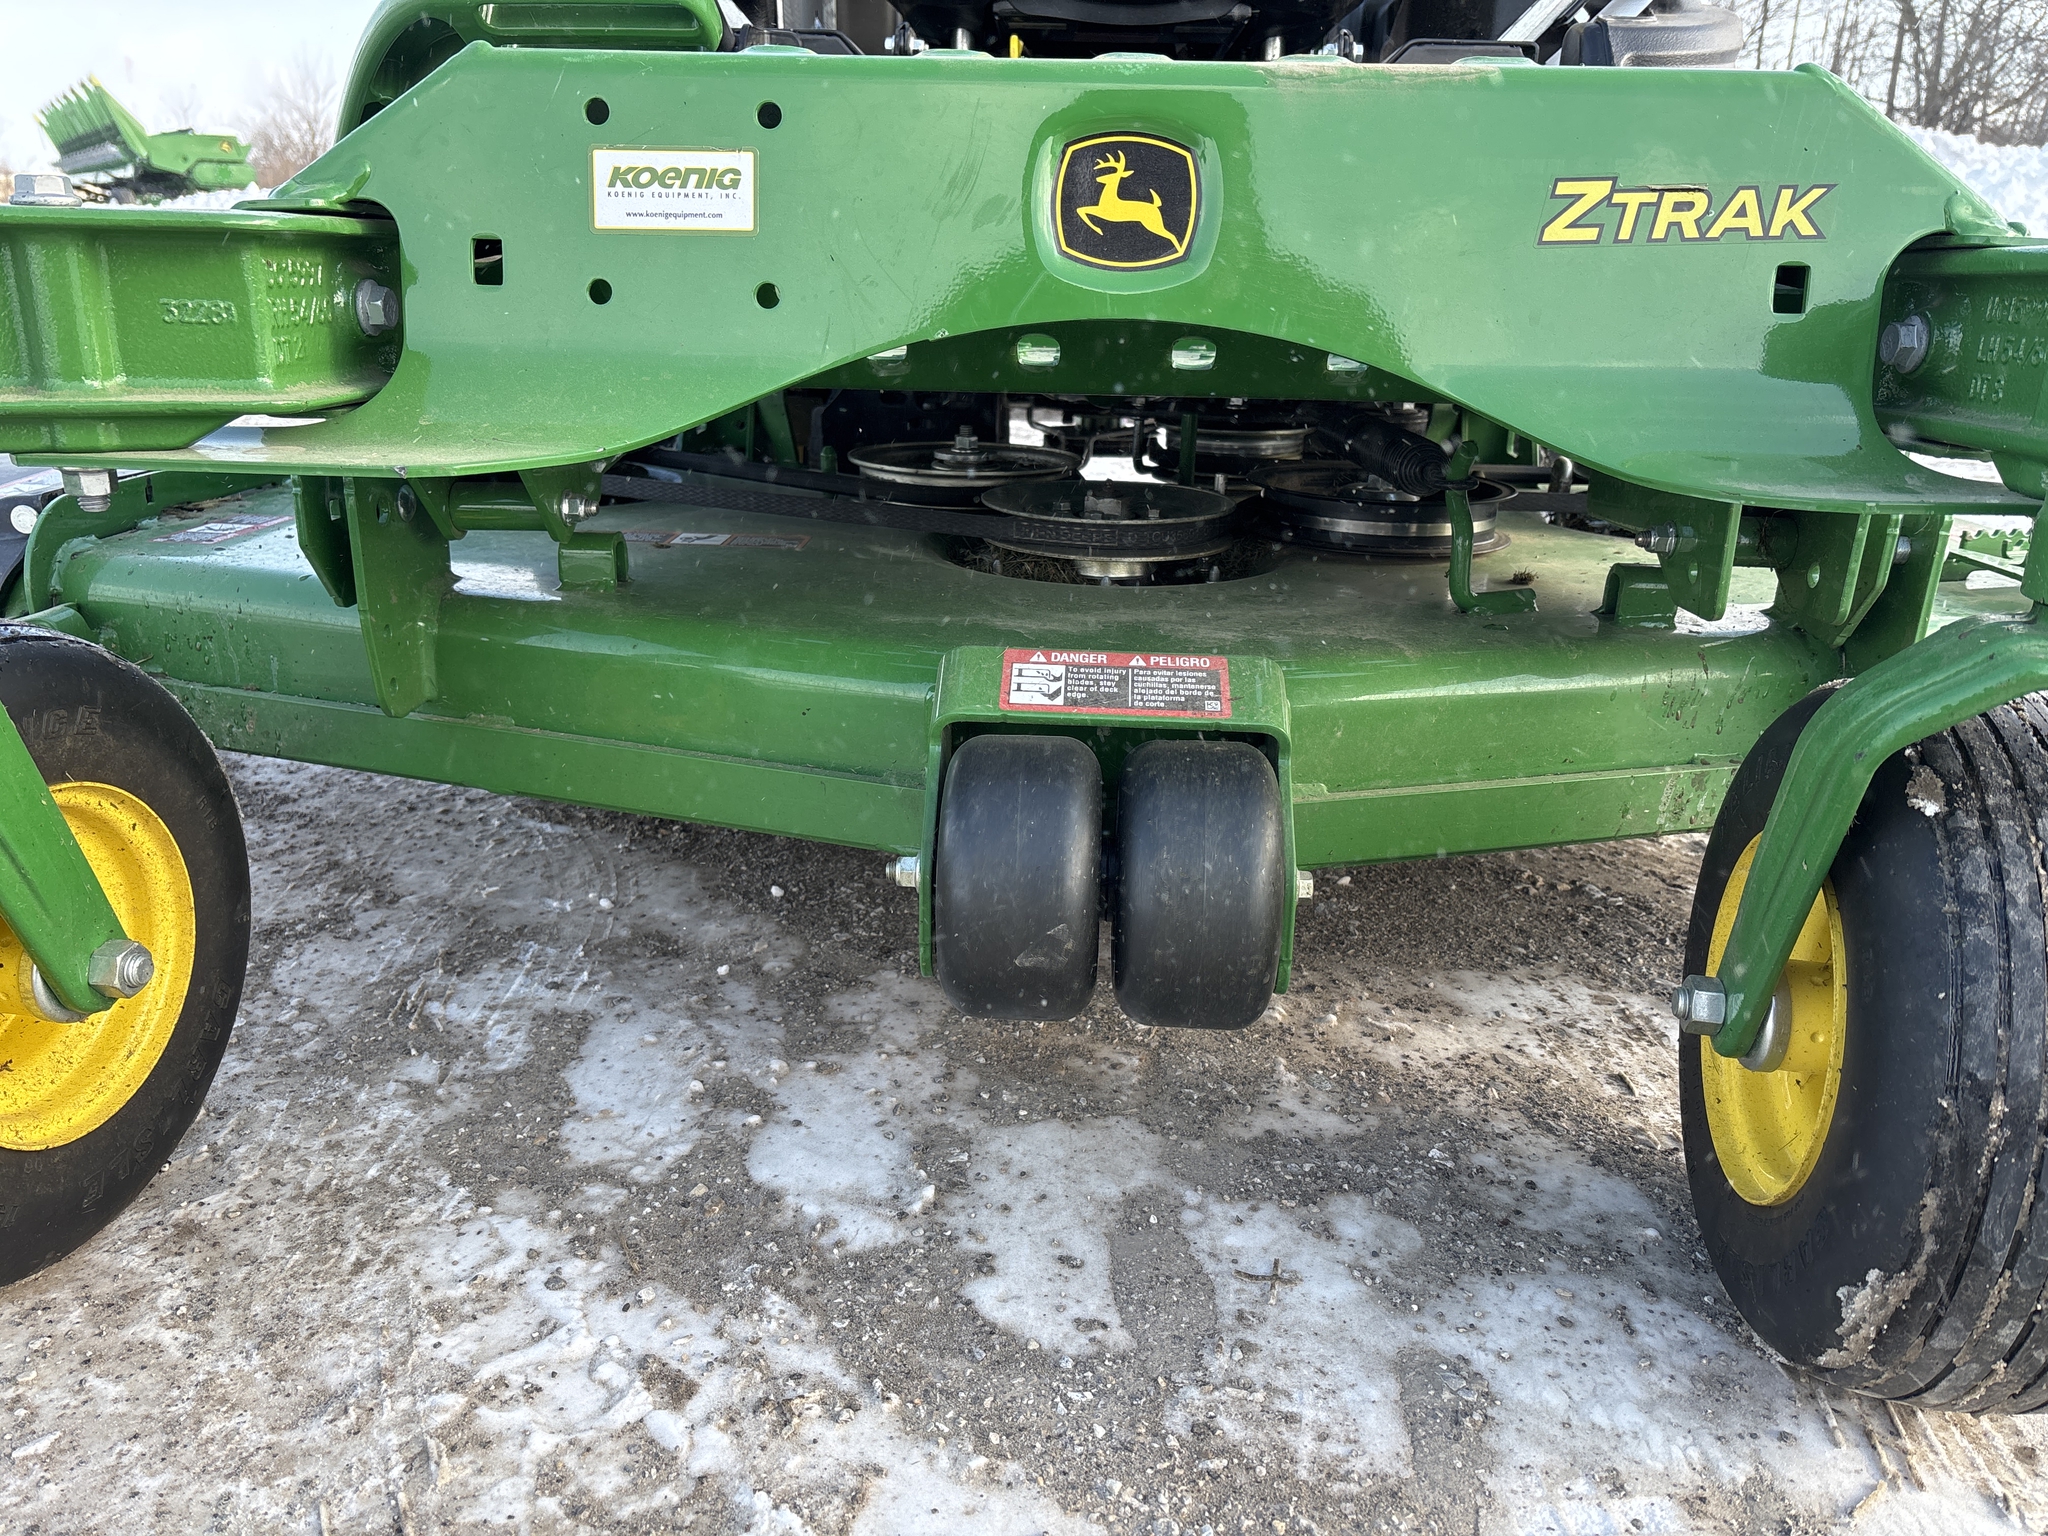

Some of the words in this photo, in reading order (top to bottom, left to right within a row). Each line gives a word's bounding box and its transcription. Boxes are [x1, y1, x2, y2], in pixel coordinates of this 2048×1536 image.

[652, 191, 713, 200] EQUIPMENT,
[625, 210, 723, 220] www.koenigequipment.com
[1537, 176, 1839, 246] ZTRAK
[1051, 652, 1108, 664] DANGER
[1150, 656, 1210, 668] PELIGRO
[1143, 694, 1185, 702] plataforma
